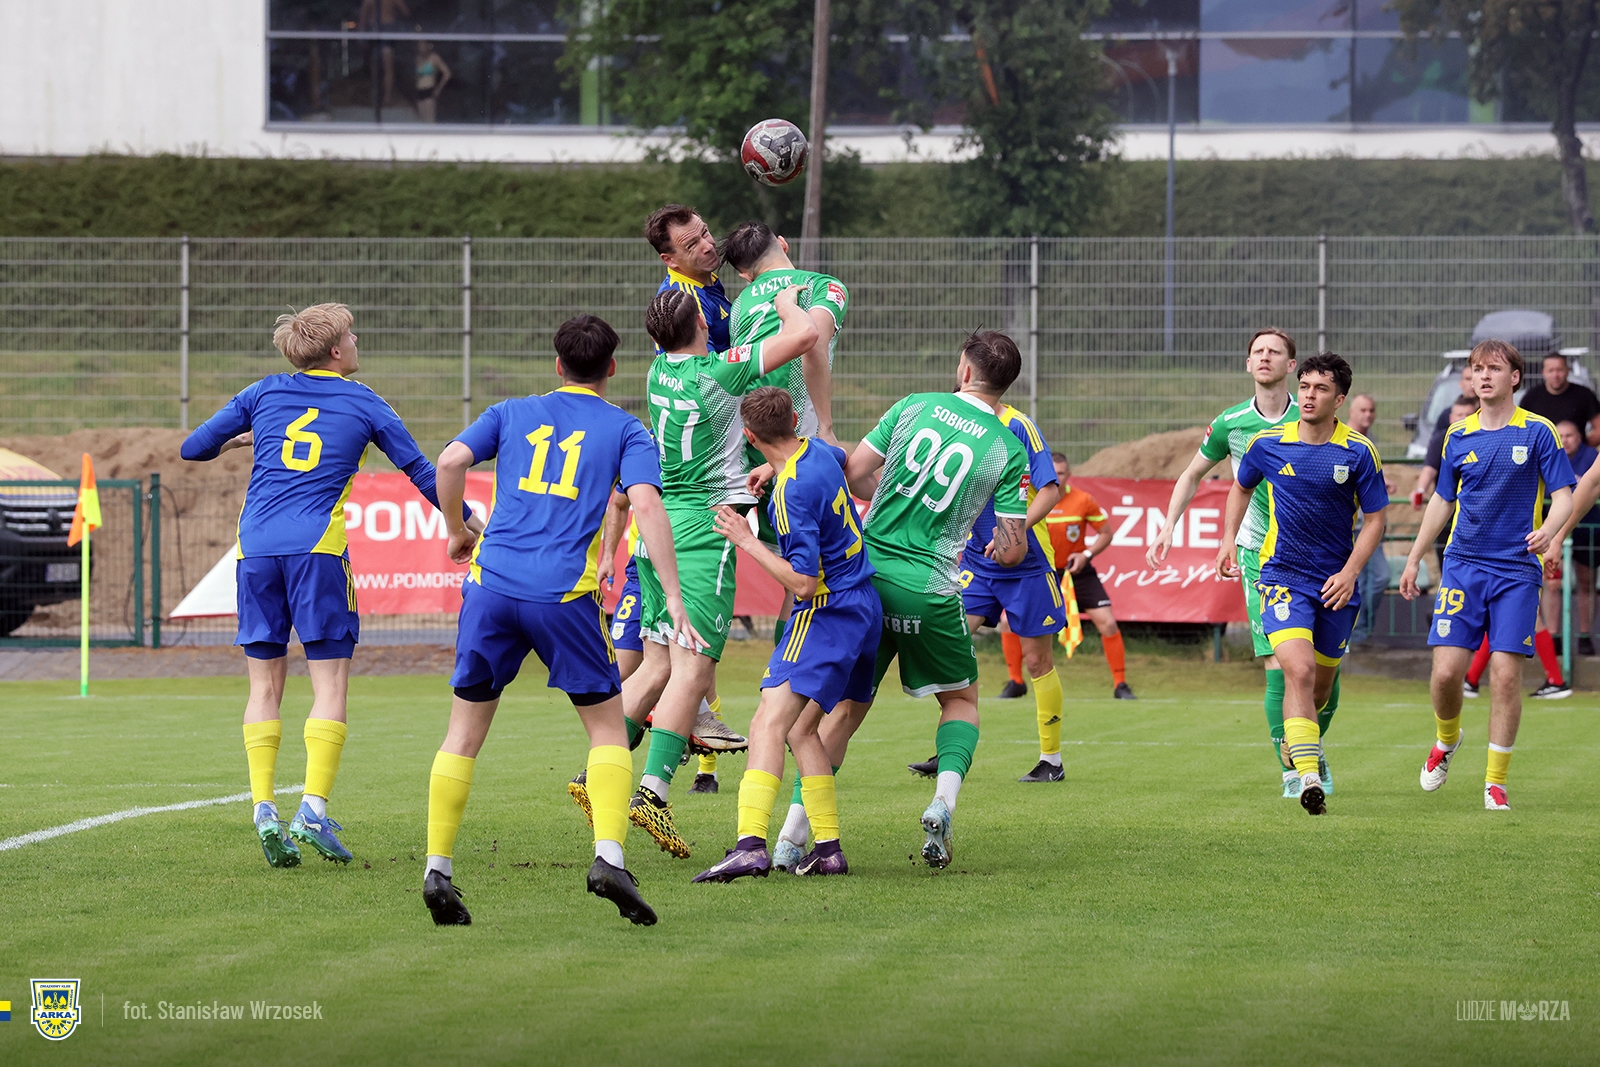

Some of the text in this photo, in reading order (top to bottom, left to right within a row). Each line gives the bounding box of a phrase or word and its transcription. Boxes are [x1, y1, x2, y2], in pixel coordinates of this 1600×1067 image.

[751, 275, 793, 297] ŁYSZYK
[280, 407, 323, 472] 6
[650, 393, 700, 463] 77
[930, 404, 988, 440] SOBKÓW
[517, 424, 586, 501] 11
[895, 427, 974, 513] 99
[1084, 495, 1223, 549] ŻNE
[617, 595, 637, 620] 8
[1434, 587, 1465, 615] 39
